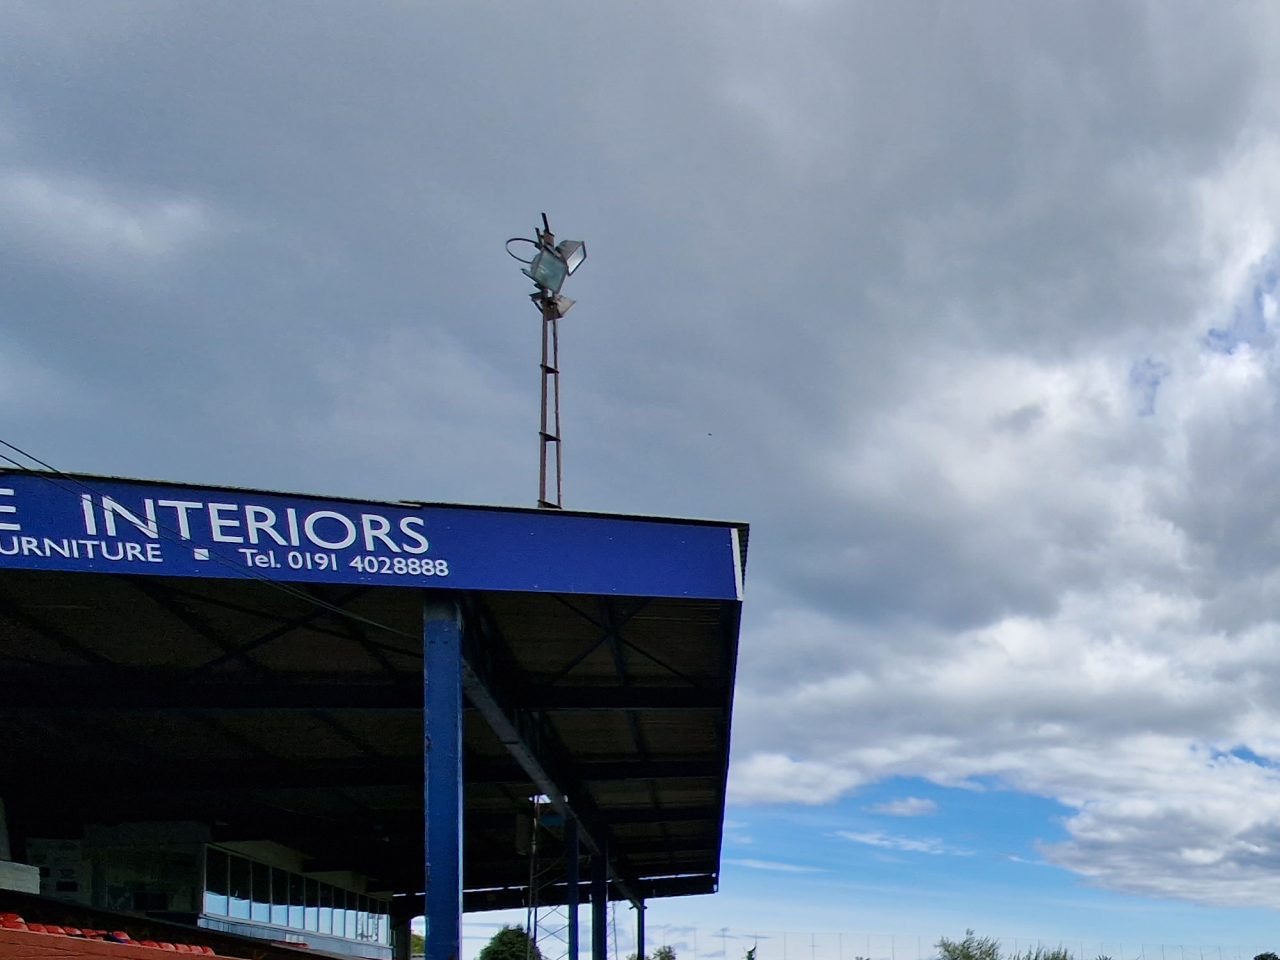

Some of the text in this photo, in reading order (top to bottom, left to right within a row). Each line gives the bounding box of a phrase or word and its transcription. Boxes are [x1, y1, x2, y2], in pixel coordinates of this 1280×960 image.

[81, 494, 430, 555] INTERIORS
[0, 535, 450, 577] URNITURE Tel. 0191 4028888
